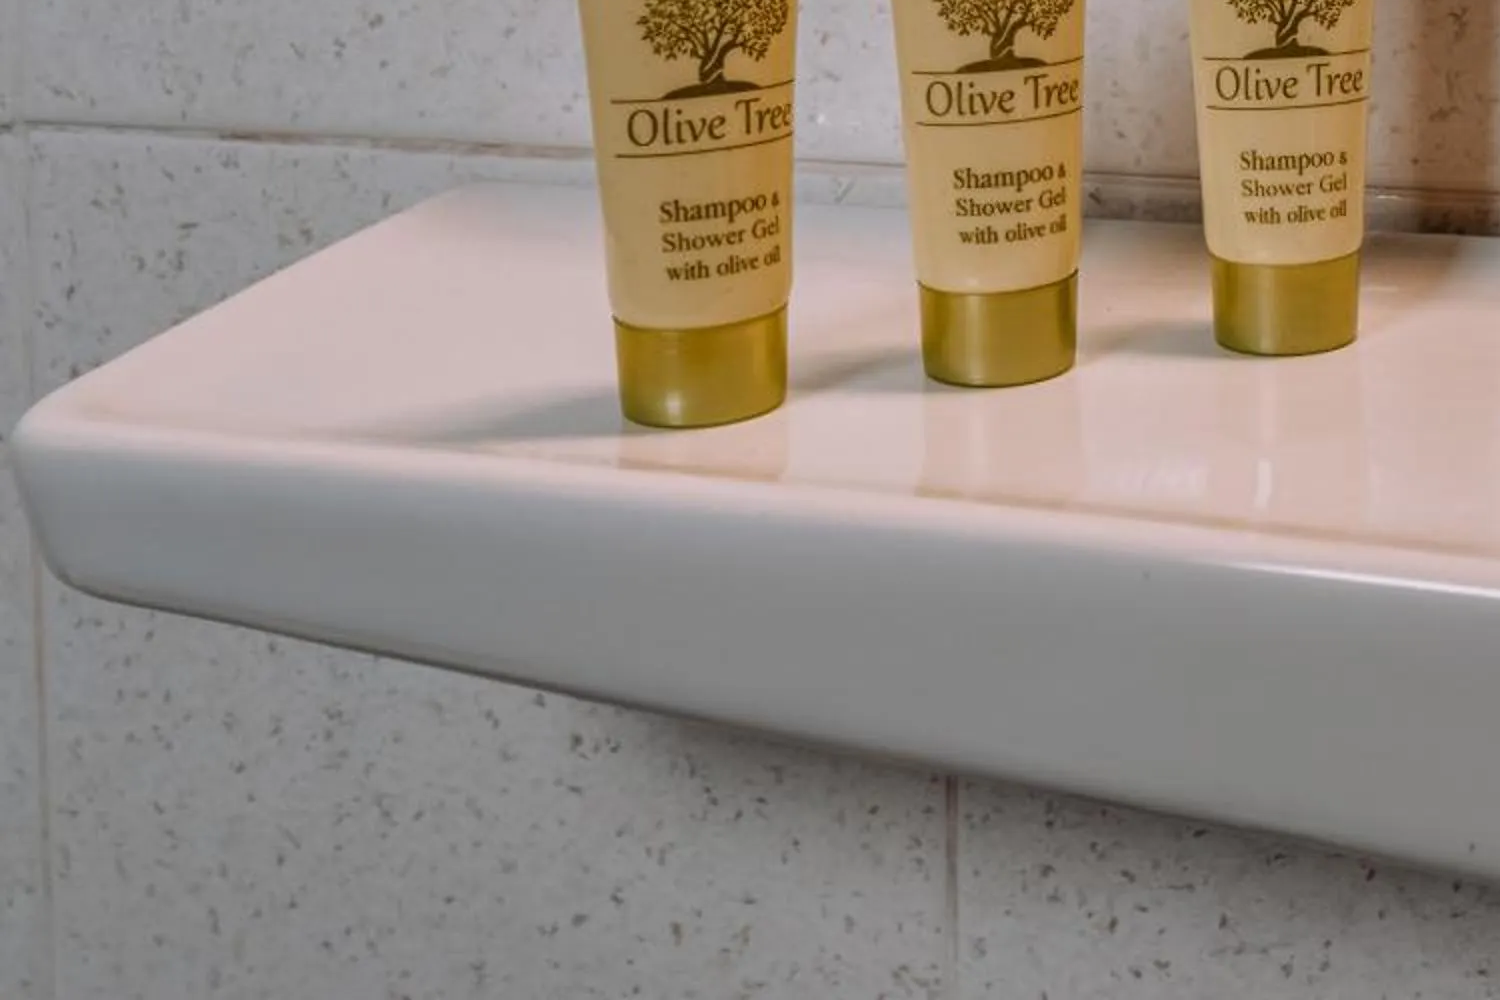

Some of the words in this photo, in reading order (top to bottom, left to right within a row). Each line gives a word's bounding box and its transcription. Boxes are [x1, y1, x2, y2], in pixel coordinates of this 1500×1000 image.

[926, 81, 1015, 117] Olive
[1024, 74, 1079, 109] Tree
[1216, 66, 1298, 100] Olive
[1306, 62, 1363, 97] Tree
[627, 108, 726, 147] Olive
[735, 98, 792, 134] Tree
[1240, 150, 1334, 175] Shampoo
[953, 164, 1053, 192] Shampoo
[1241, 179, 1313, 197] Shower
[1320, 174, 1347, 193] Gel
[660, 194, 766, 223] Shampoo
[956, 198, 1032, 217] Shower
[1039, 187, 1066, 209] Gel
[1245, 207, 1281, 225] with
[1288, 205, 1325, 223] olive
[1330, 200, 1347, 217] oil
[662, 228, 746, 253] Shower
[752, 216, 779, 239] Gel
[959, 225, 998, 245] with
[1005, 222, 1046, 242] olive
[1050, 214, 1067, 234] oil
[667, 263, 710, 281] with
[717, 255, 759, 276] olive
[764, 245, 781, 266] oil
